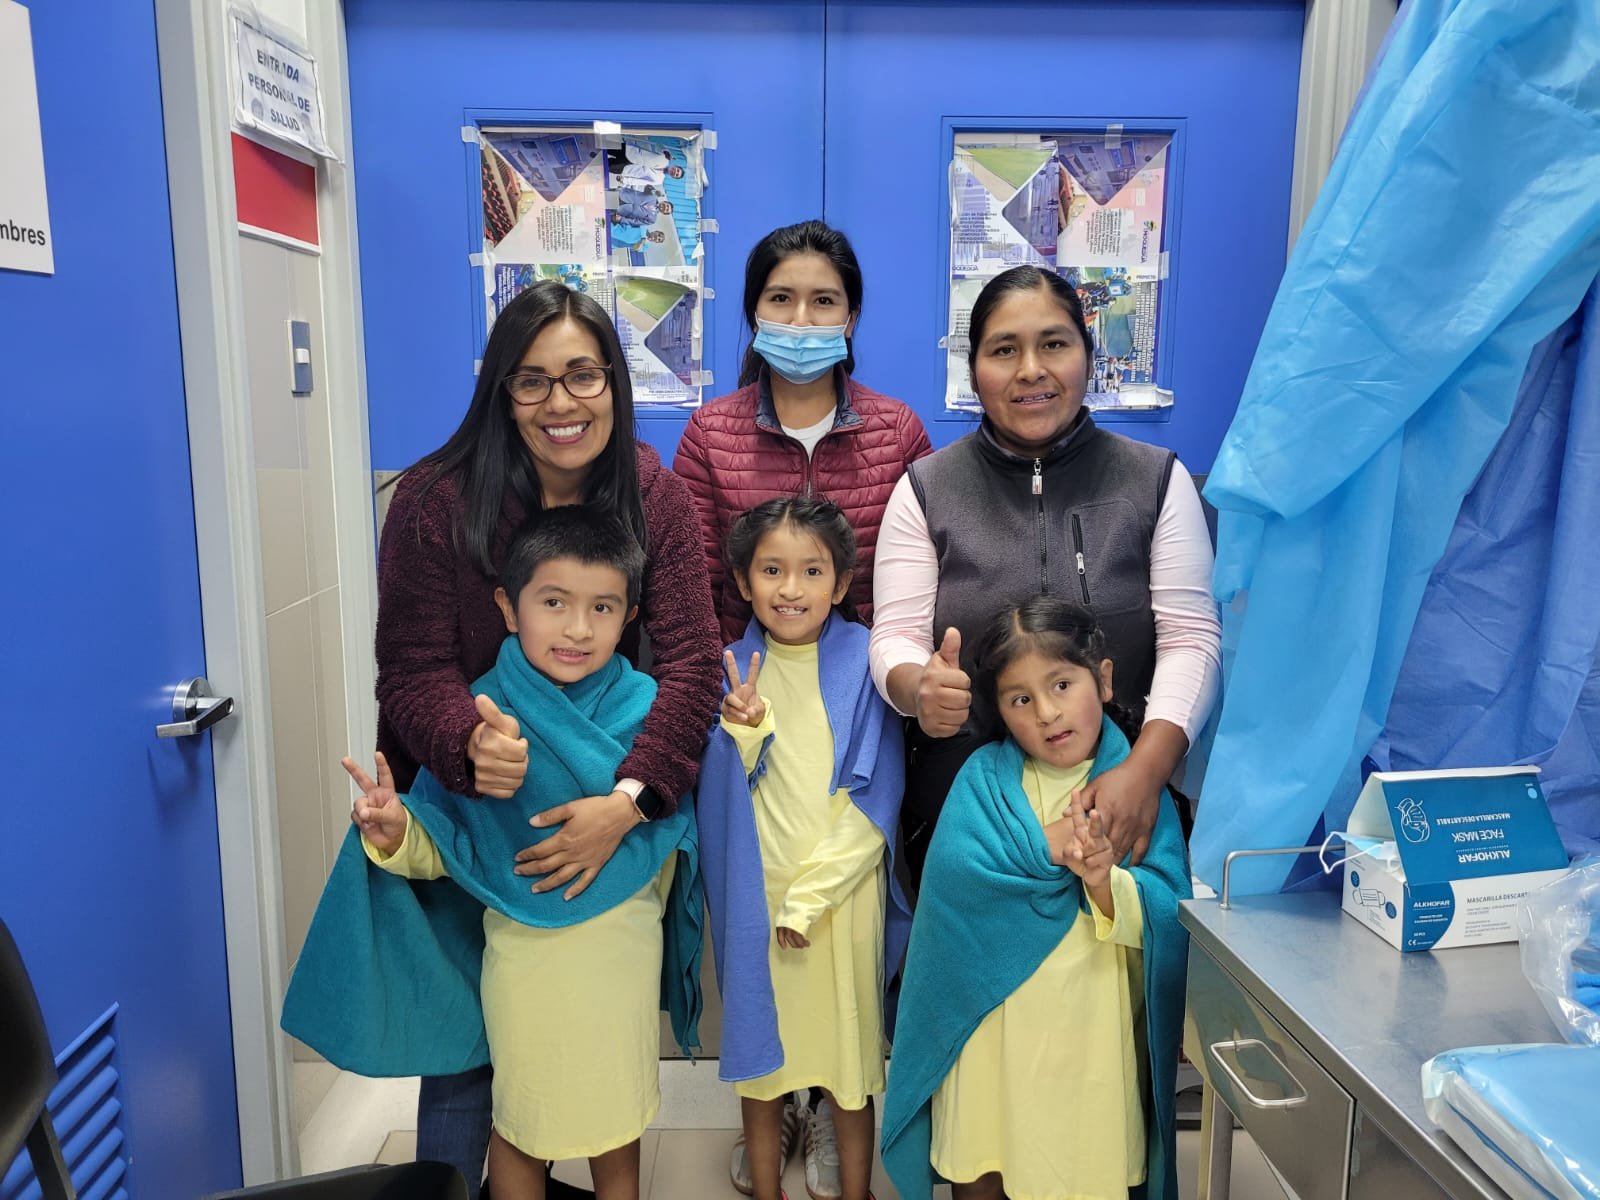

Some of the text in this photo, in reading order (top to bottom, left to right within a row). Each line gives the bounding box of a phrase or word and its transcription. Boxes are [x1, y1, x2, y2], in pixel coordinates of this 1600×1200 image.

[256, 48, 300, 83] ENTRADA
[248, 72, 311, 113] PERSONAL DE
[270, 108, 301, 131] SALUD
[1436, 812, 1511, 826] MASCARILLA DESCARTABLE
[1451, 828, 1505, 843] FACE MASK
[1457, 848, 1511, 864] ALKHOFAR
[1413, 899, 1450, 909] ALKHOFAR
[1466, 894, 1503, 905] MASCARILLA
